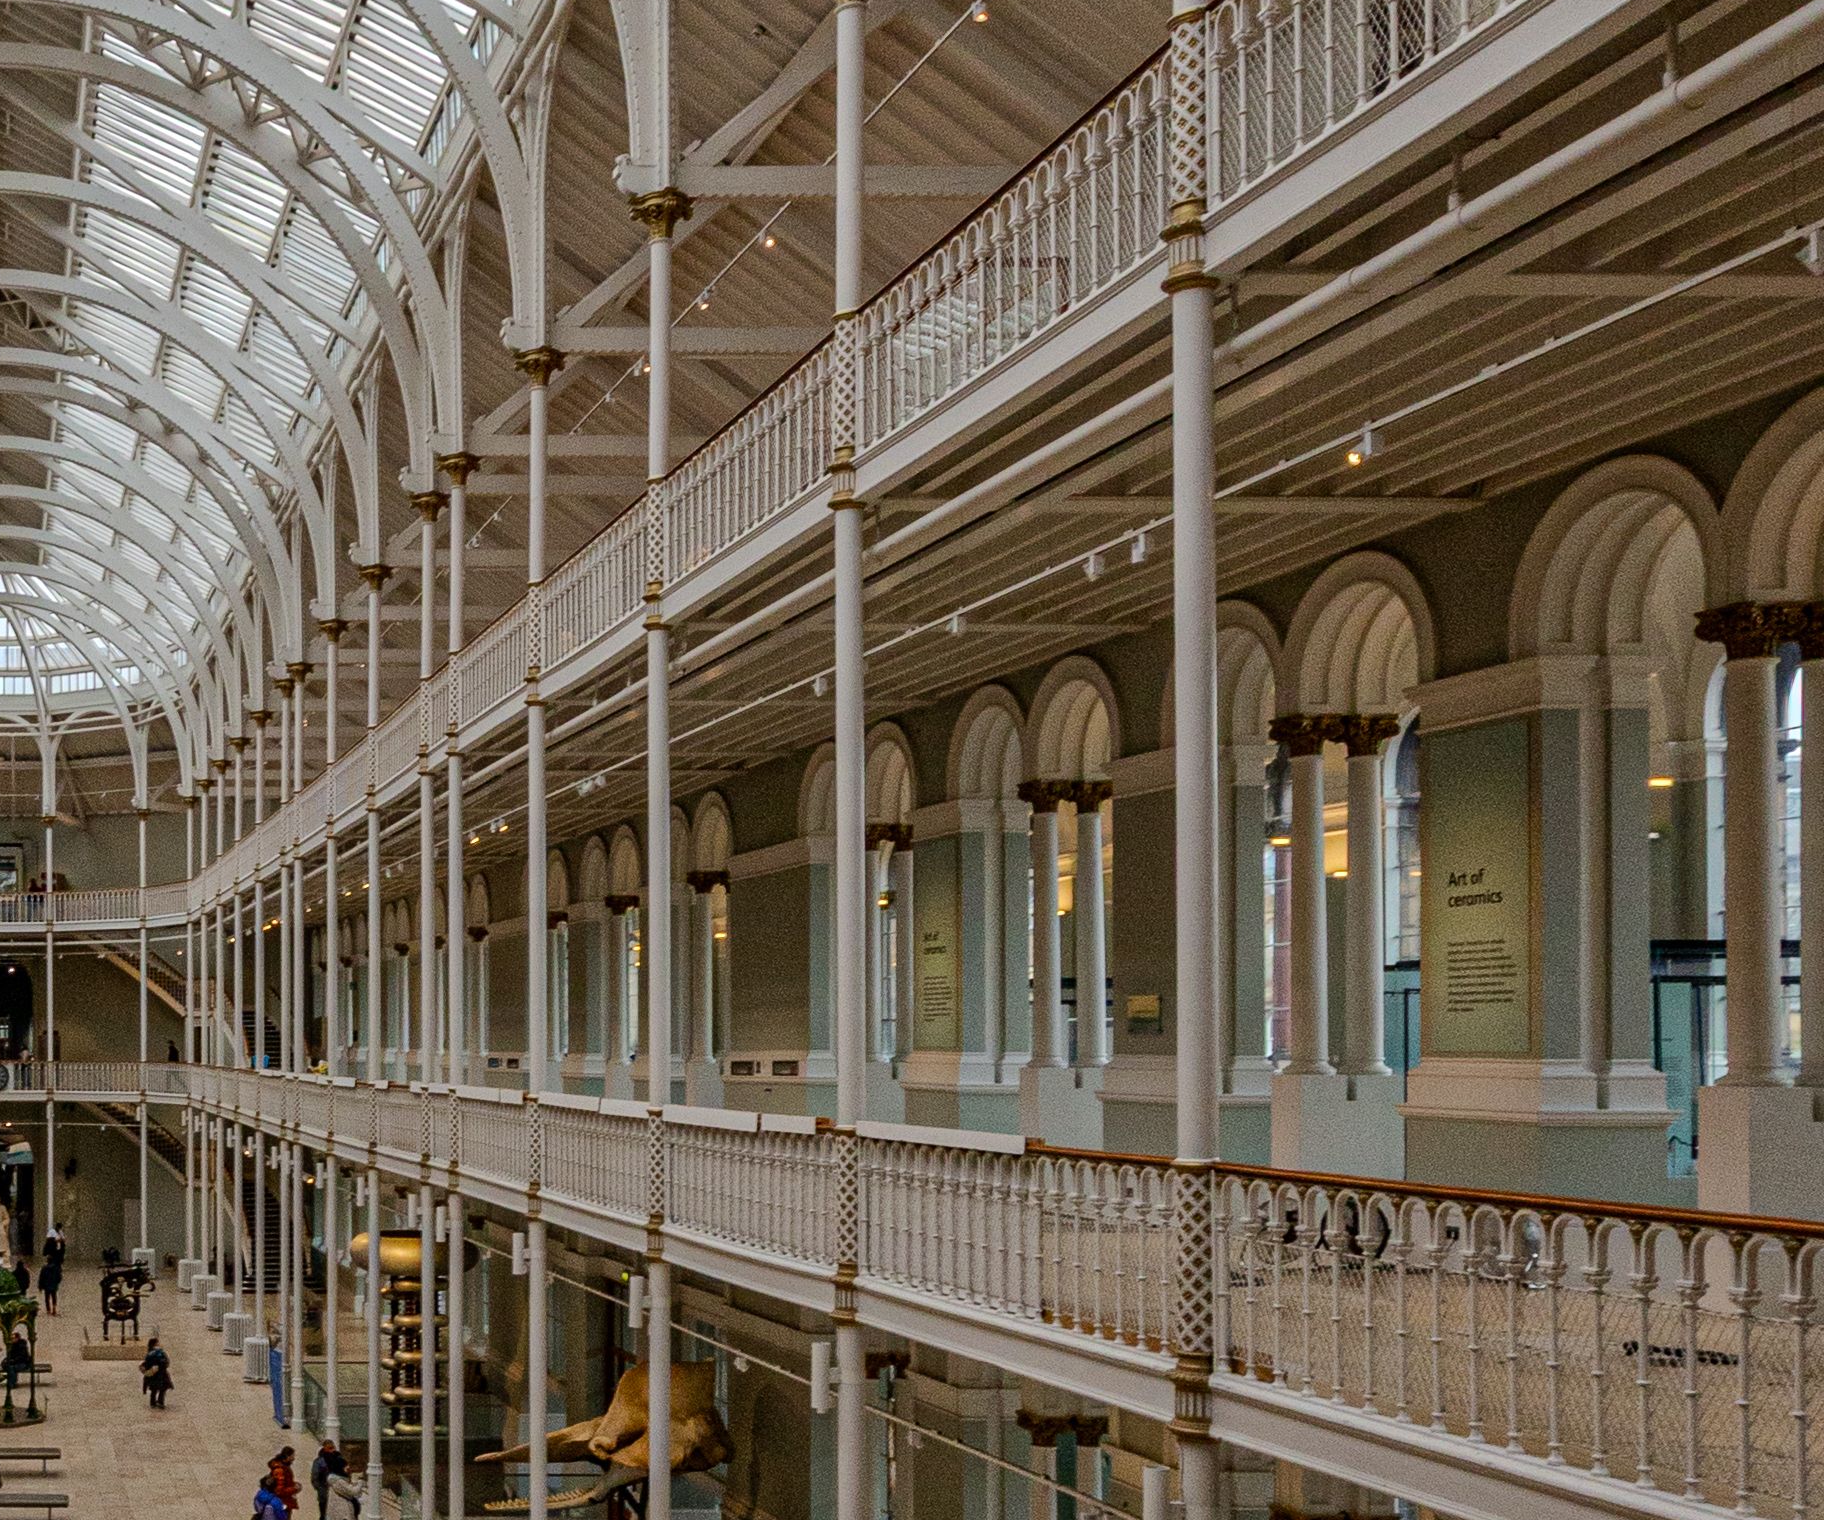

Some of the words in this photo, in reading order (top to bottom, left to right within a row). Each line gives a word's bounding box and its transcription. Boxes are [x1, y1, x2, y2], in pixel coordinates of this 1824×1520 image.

[1448, 871, 1467, 887] Art
[1470, 868, 1485, 885] of
[1448, 890, 1503, 908] ceramics
